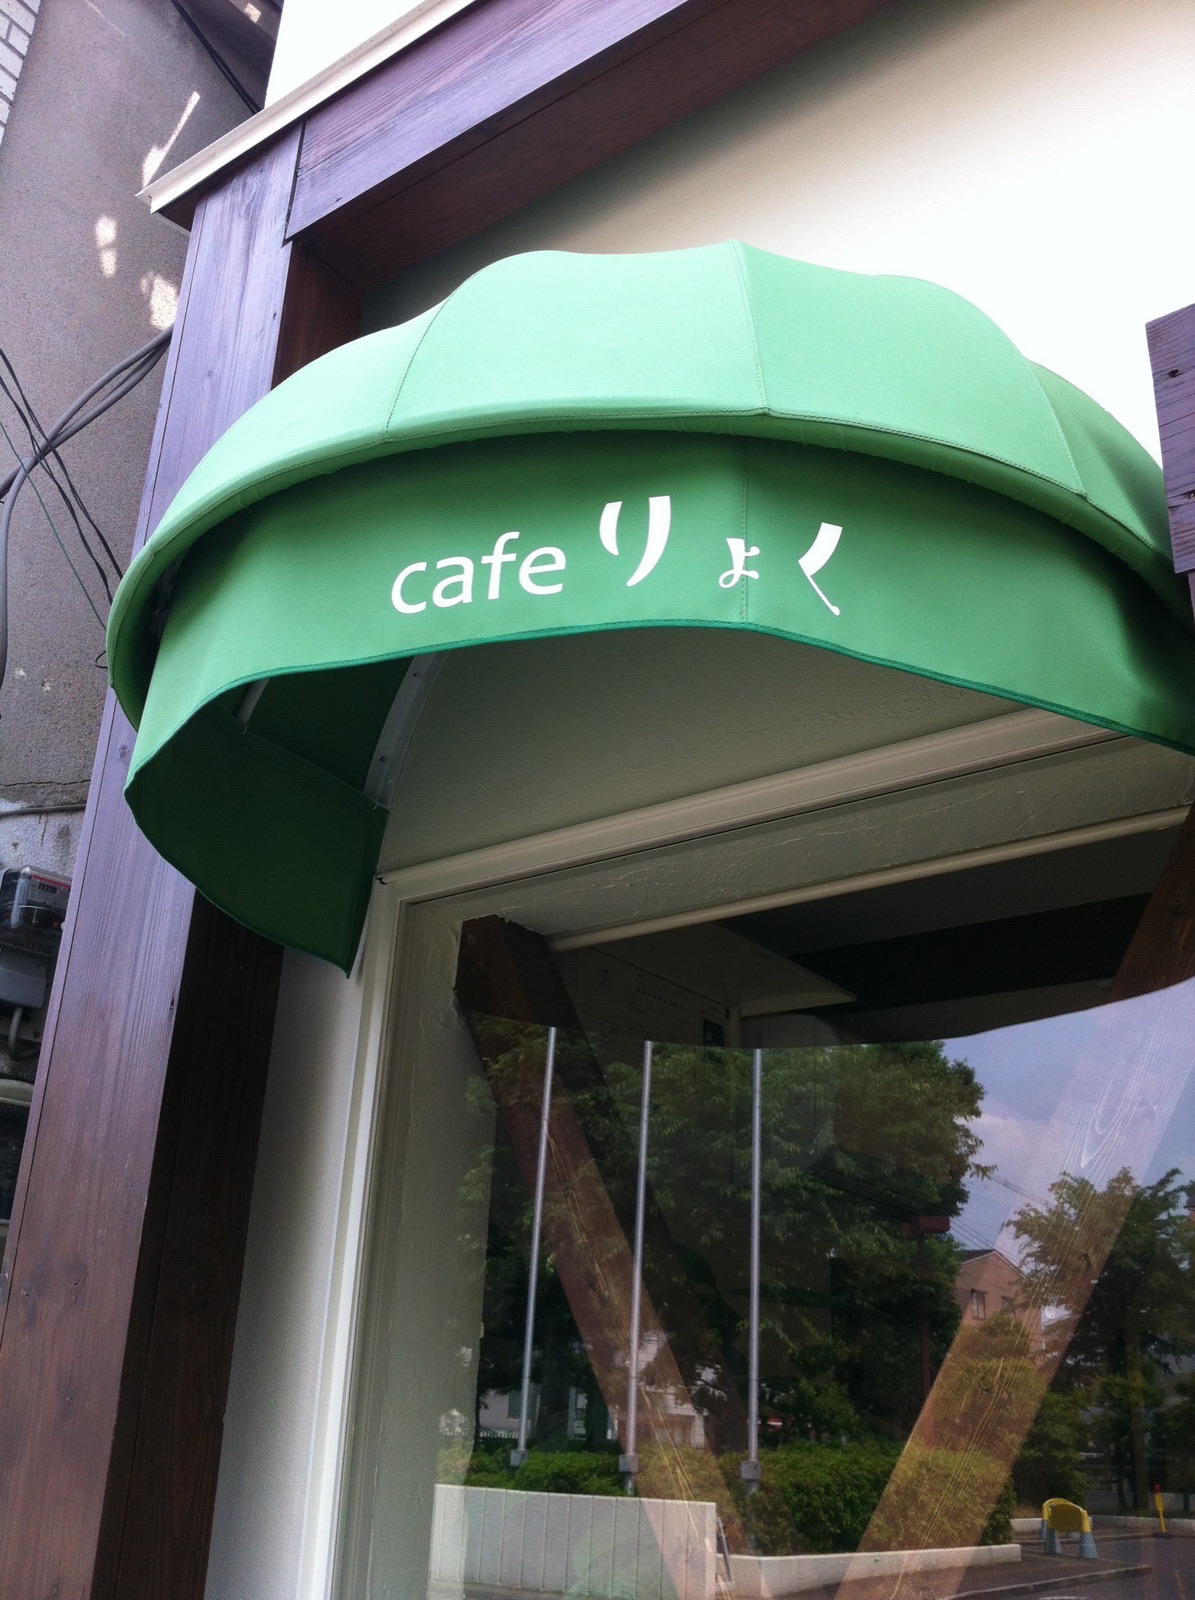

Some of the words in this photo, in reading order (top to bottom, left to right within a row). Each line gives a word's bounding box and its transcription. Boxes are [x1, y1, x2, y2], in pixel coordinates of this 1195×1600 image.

[391, 531, 566, 614] cafe
[599, 495, 843, 616] りょく
